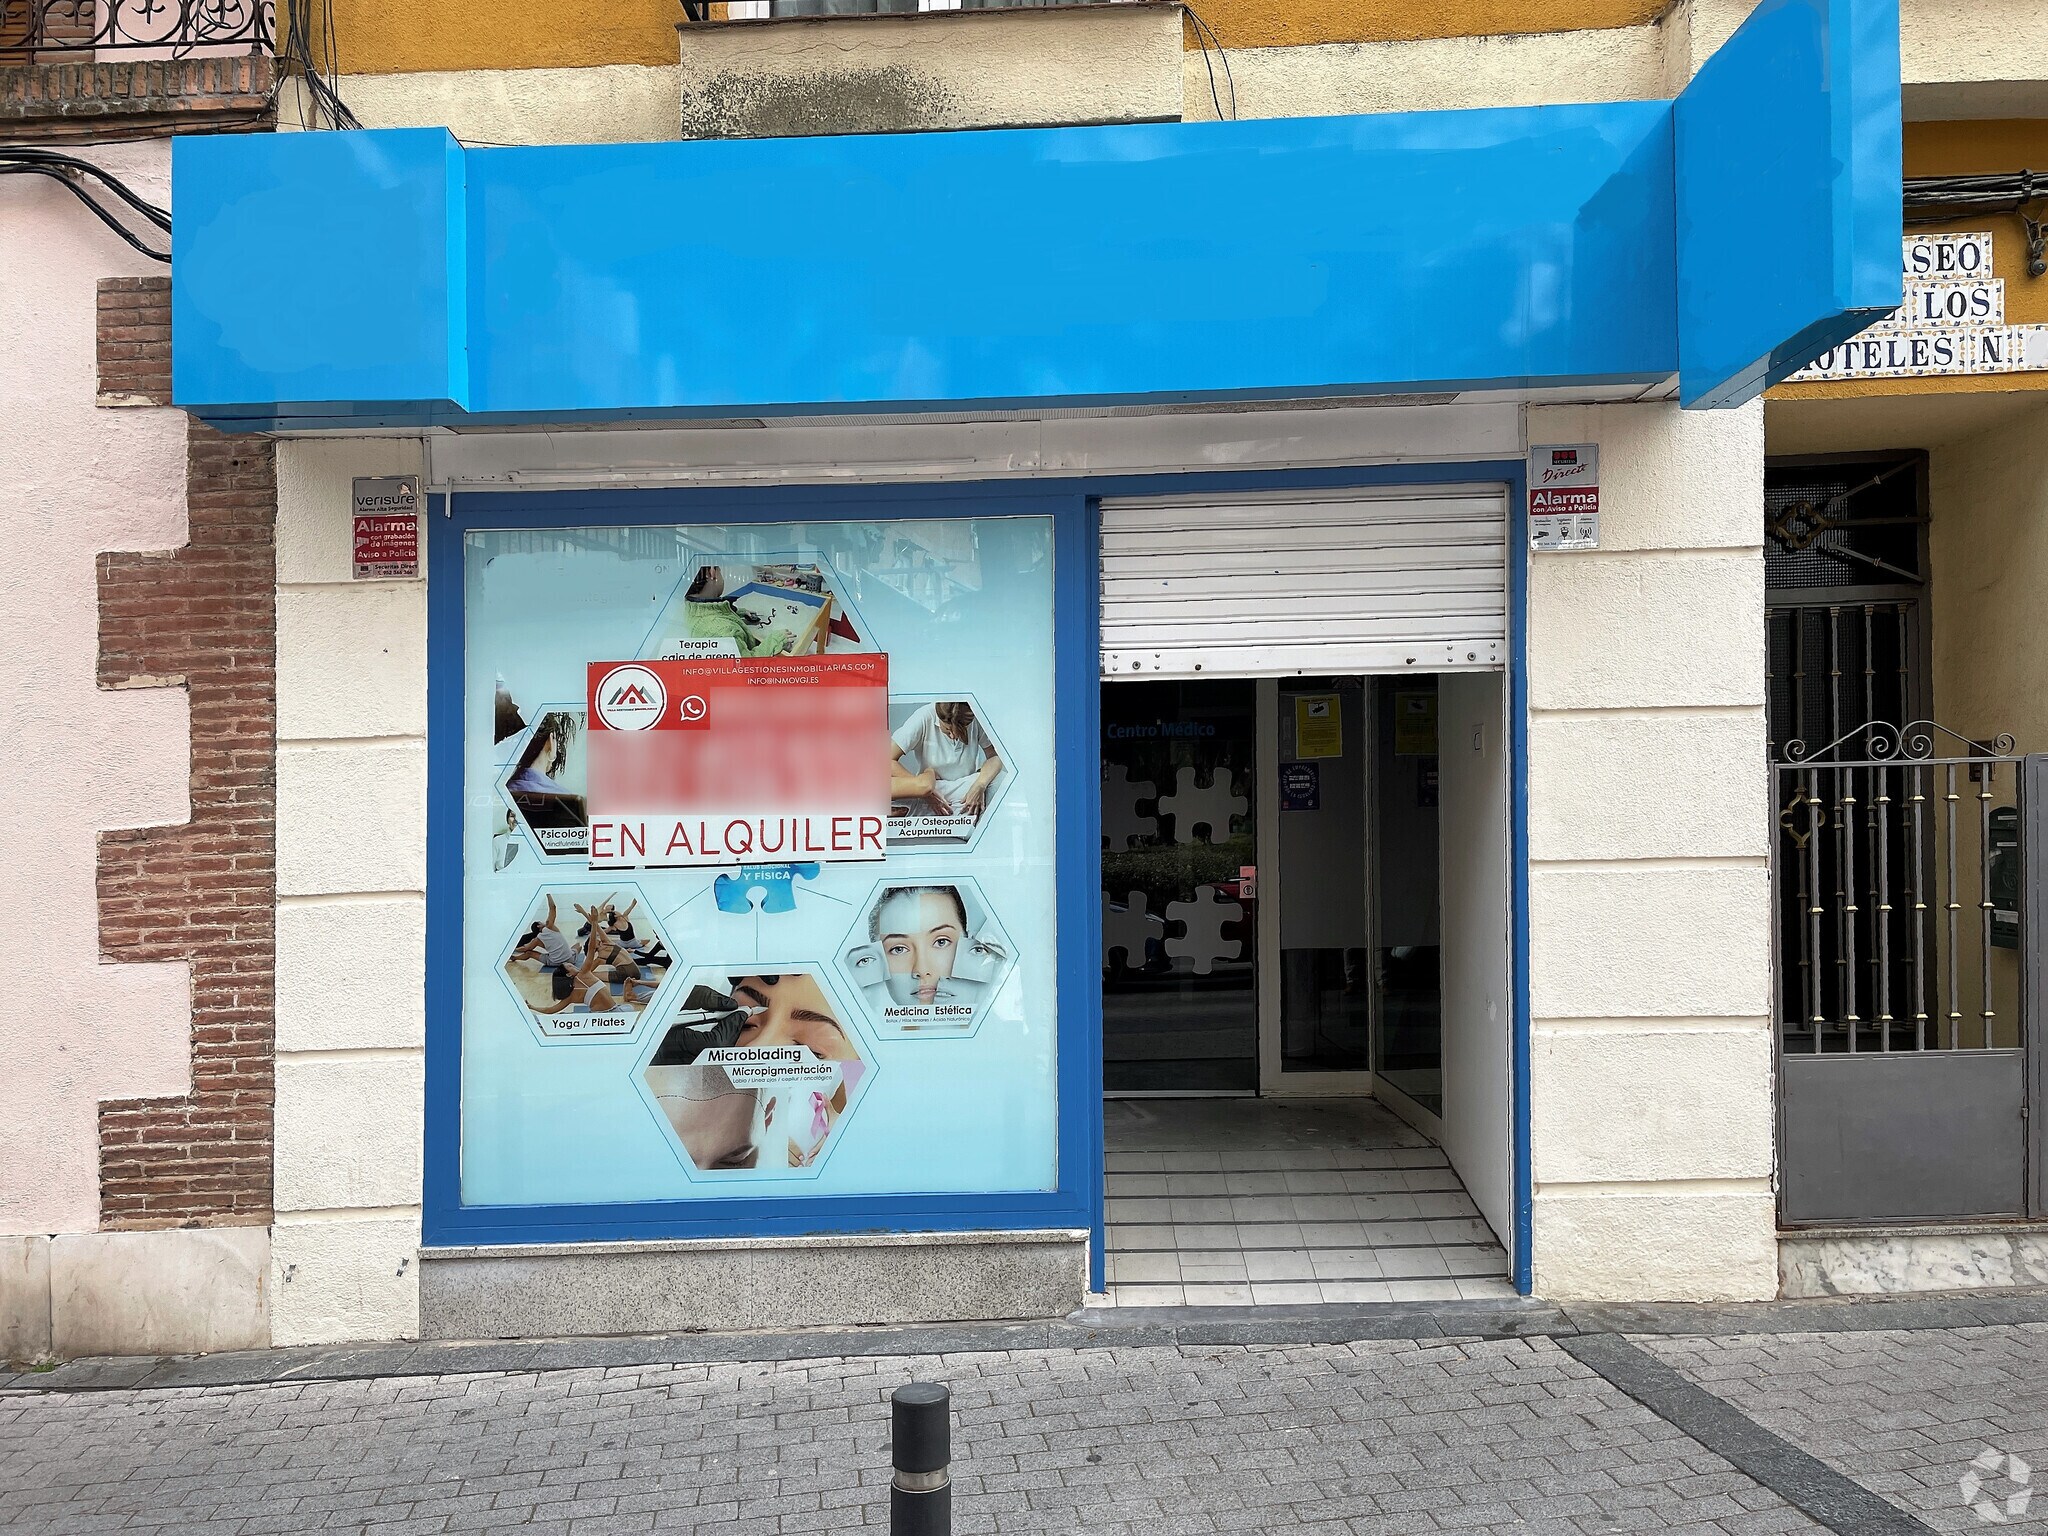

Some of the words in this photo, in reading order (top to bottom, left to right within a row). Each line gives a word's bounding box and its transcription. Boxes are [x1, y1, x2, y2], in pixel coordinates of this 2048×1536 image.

[1903, 242, 1981, 273] SEO
[1924, 287, 1990, 319] LOS
[1799, 337, 1954, 371] OTELES
[1980, 334, 2003, 364] N
[356, 495, 415, 505] verisure
[1533, 491, 1597, 506] Alarma
[356, 520, 416, 532] Alarma
[370, 540, 381, 548] de
[357, 551, 380, 559] Aviso
[389, 549, 416, 557] Policía
[679, 640, 719, 650] Terapia
[682, 663, 875, 676] INFO@VILLAGESTIONESINMOBILIARIAS.COM
[1107, 723, 1157, 738] Centro
[1161, 720, 1216, 736] Médico
[886, 820, 912, 828] asaje
[592, 823, 646, 857] EN
[665, 817, 883, 855] ALQUILER
[898, 828, 952, 837] Acupuntura
[754, 871, 791, 880] FÍSICA
[884, 1006, 930, 1017] Medicina
[935, 1005, 972, 1015] Estética
[552, 1019, 580, 1029] Yoga
[591, 1017, 626, 1027] Pilates
[708, 1047, 802, 1062] Microblading
[732, 1064, 832, 1077] Micropigmentación
